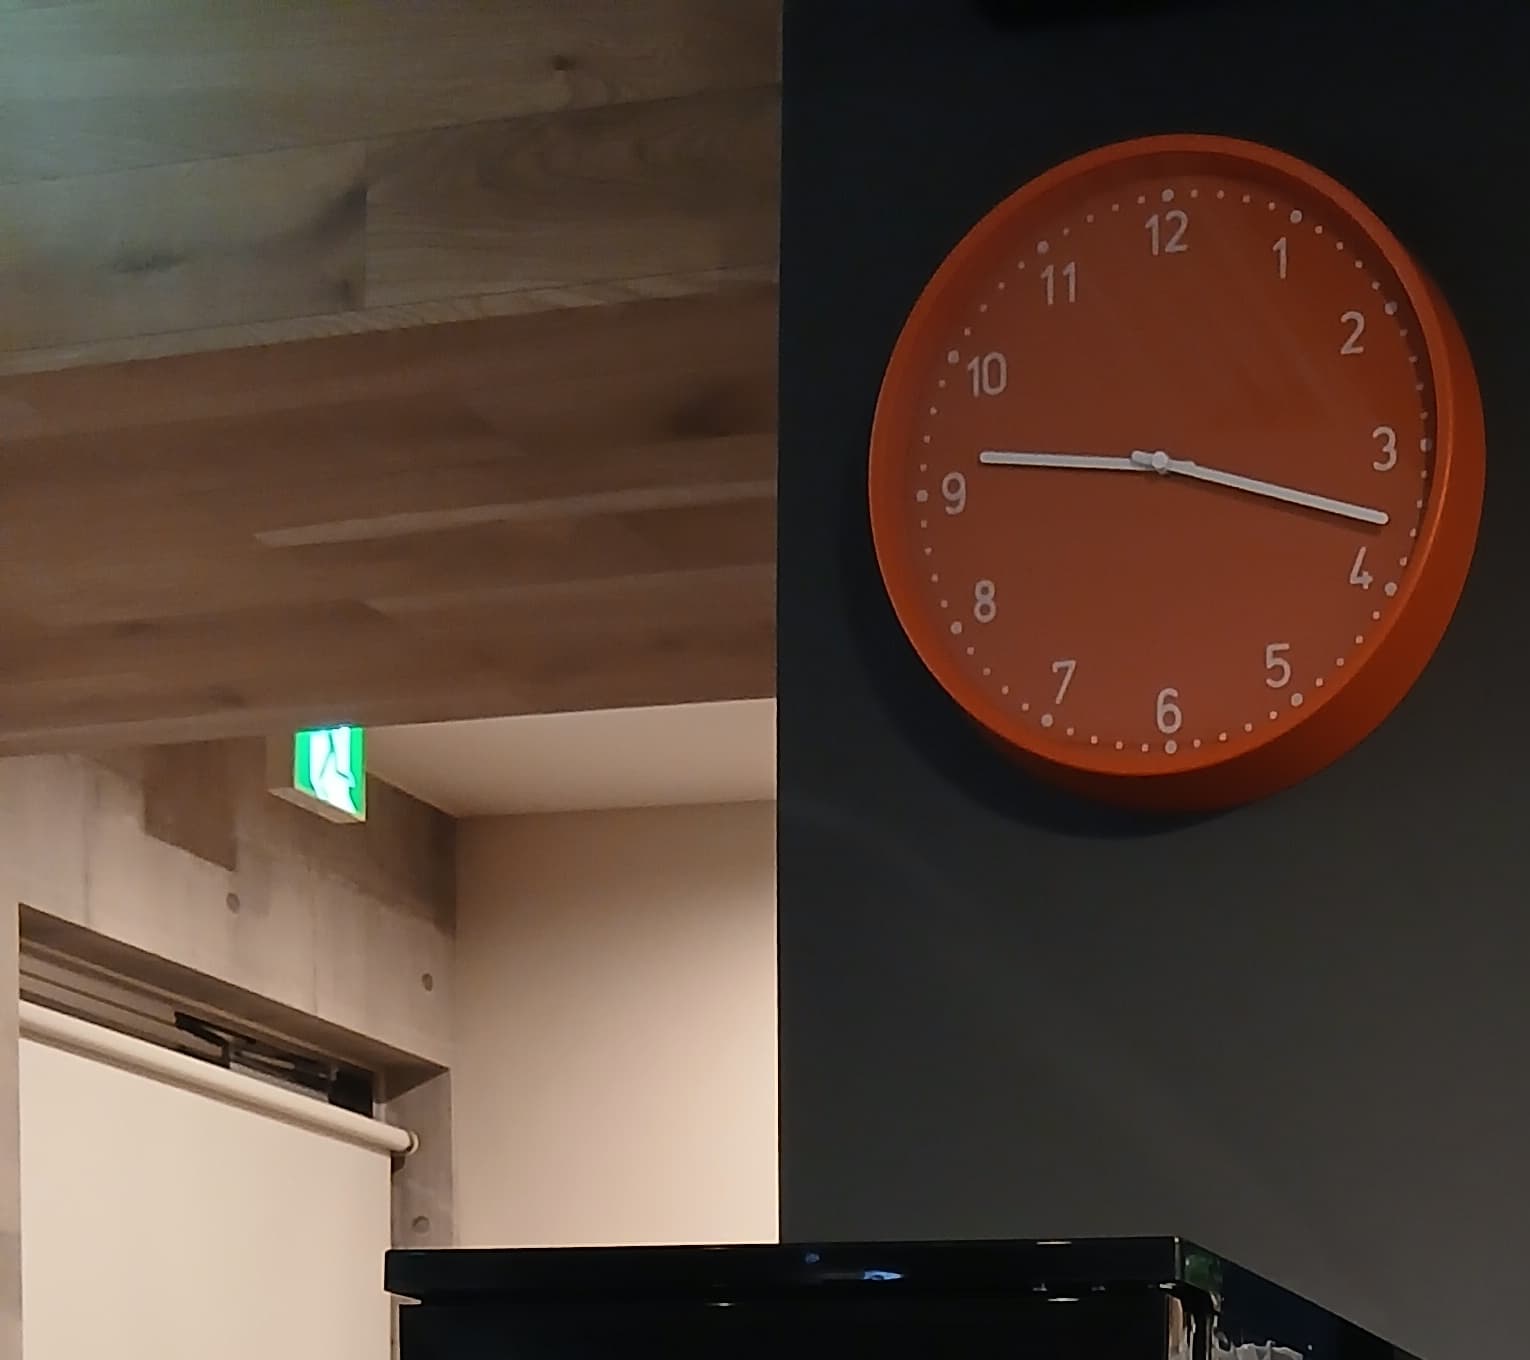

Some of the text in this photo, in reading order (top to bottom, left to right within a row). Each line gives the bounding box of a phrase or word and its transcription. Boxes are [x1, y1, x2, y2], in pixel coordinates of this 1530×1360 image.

[1145, 210, 1189, 256] 12
[1273, 237, 1287, 279] 1
[1040, 262, 1076, 304] 11
[1340, 311, 1366, 355] 2
[967, 352, 1008, 397] 10
[1373, 426, 1397, 471] 3
[942, 471, 966, 514] 9
[1349, 546, 1373, 590] 4
[974, 579, 997, 623] 8
[1052, 660, 1076, 704] 7
[1265, 643, 1291, 688] 5
[1156, 687, 1182, 733] 6
